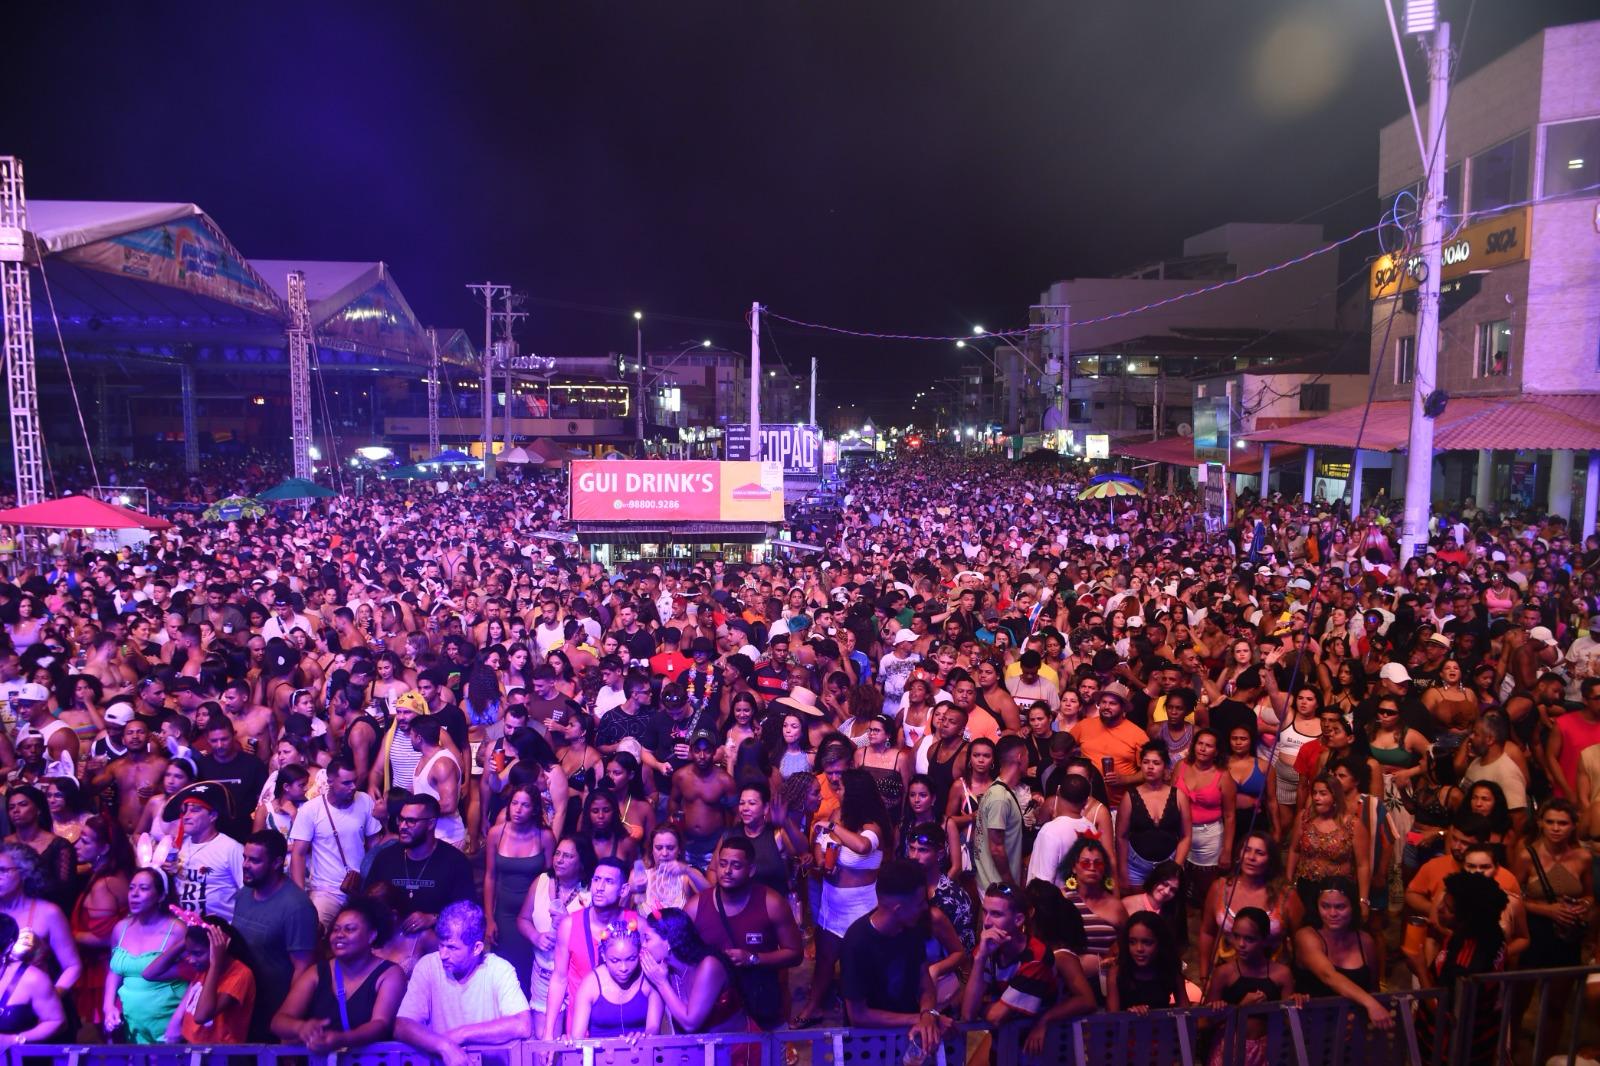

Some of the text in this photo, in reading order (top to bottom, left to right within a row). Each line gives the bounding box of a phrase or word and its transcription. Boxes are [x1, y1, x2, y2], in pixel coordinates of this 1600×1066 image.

[1441, 240, 1470, 266] JOÃO
[758, 427, 814, 468] COPÃO
[579, 472, 714, 493] GUI DRINK'S
